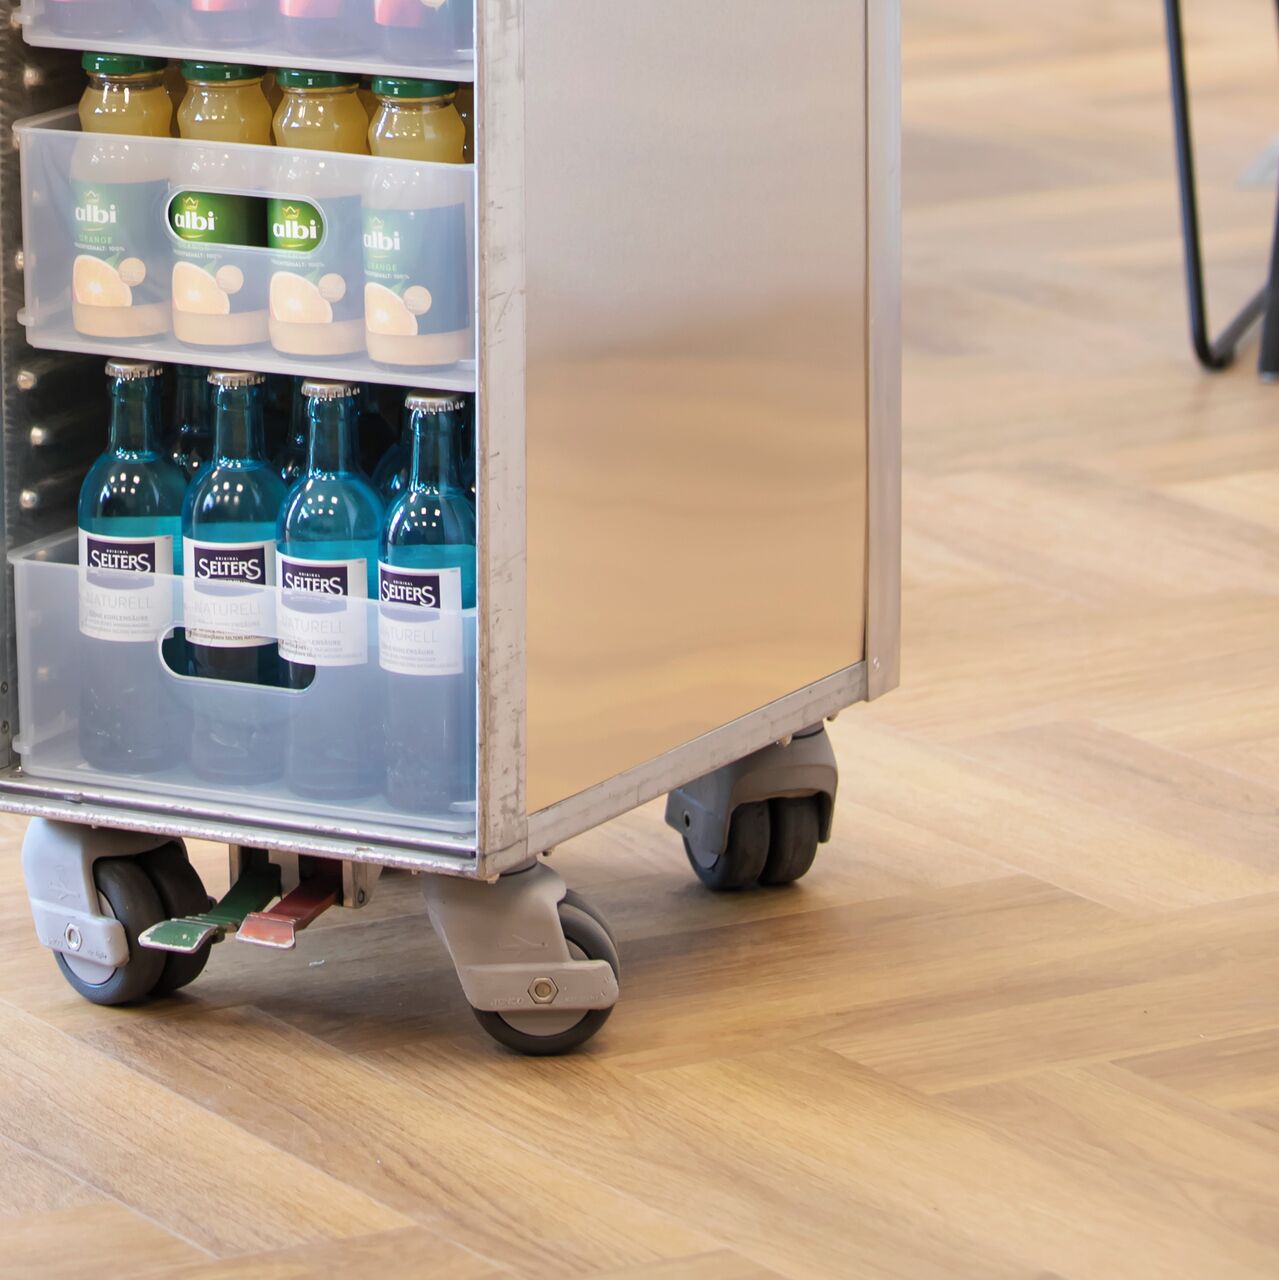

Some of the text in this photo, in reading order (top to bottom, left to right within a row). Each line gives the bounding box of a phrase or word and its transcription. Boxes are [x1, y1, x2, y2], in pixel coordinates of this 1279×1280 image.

[74, 203, 117, 224] albi
[175, 210, 215, 231] albi
[272, 219, 317, 239] albi
[363, 230, 401, 251] albi
[90, 549, 152, 573] SELTERS
[197, 558, 262, 580] SELTERS
[283, 572, 344, 596] SELTERS
[381, 579, 436, 607] SELTERS
